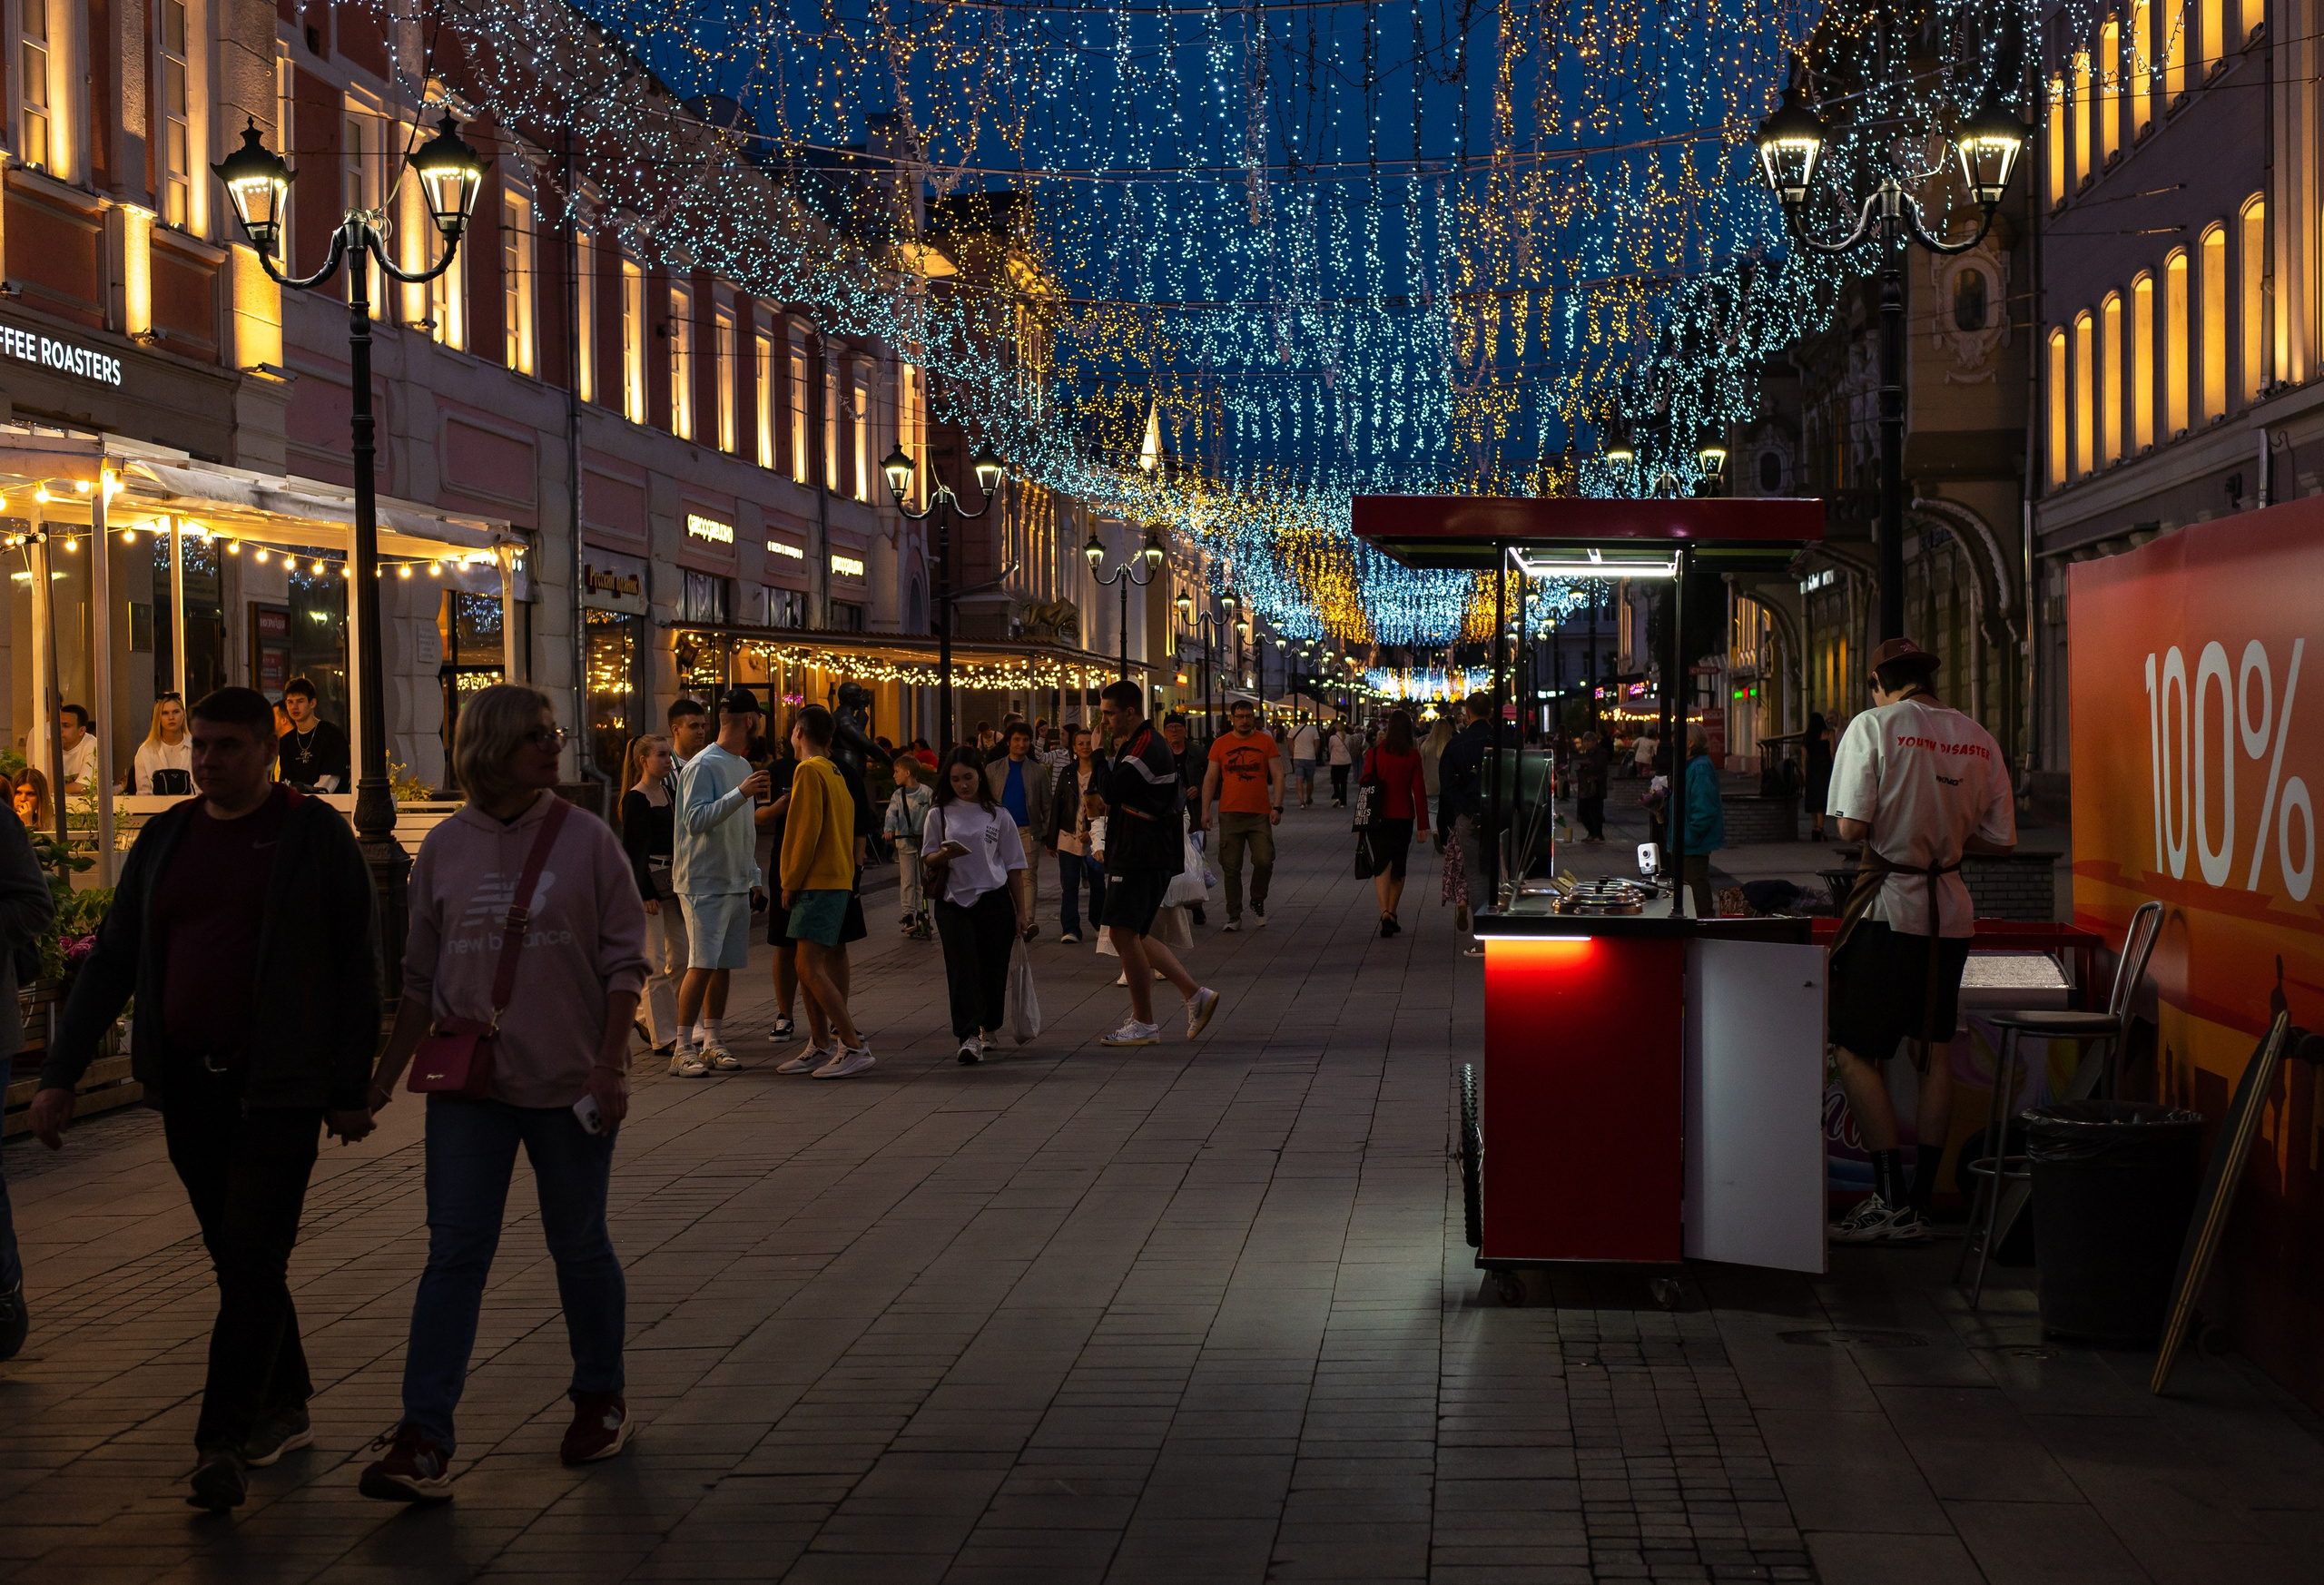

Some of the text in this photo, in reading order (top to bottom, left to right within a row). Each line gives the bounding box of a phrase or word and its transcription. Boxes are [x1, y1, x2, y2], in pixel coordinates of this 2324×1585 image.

[41, 337, 122, 386] ROASTERS
[1897, 736, 1990, 761] YOUTH DISASTER
[2145, 638, 2315, 901] 100%
[448, 930, 573, 954] new bance
